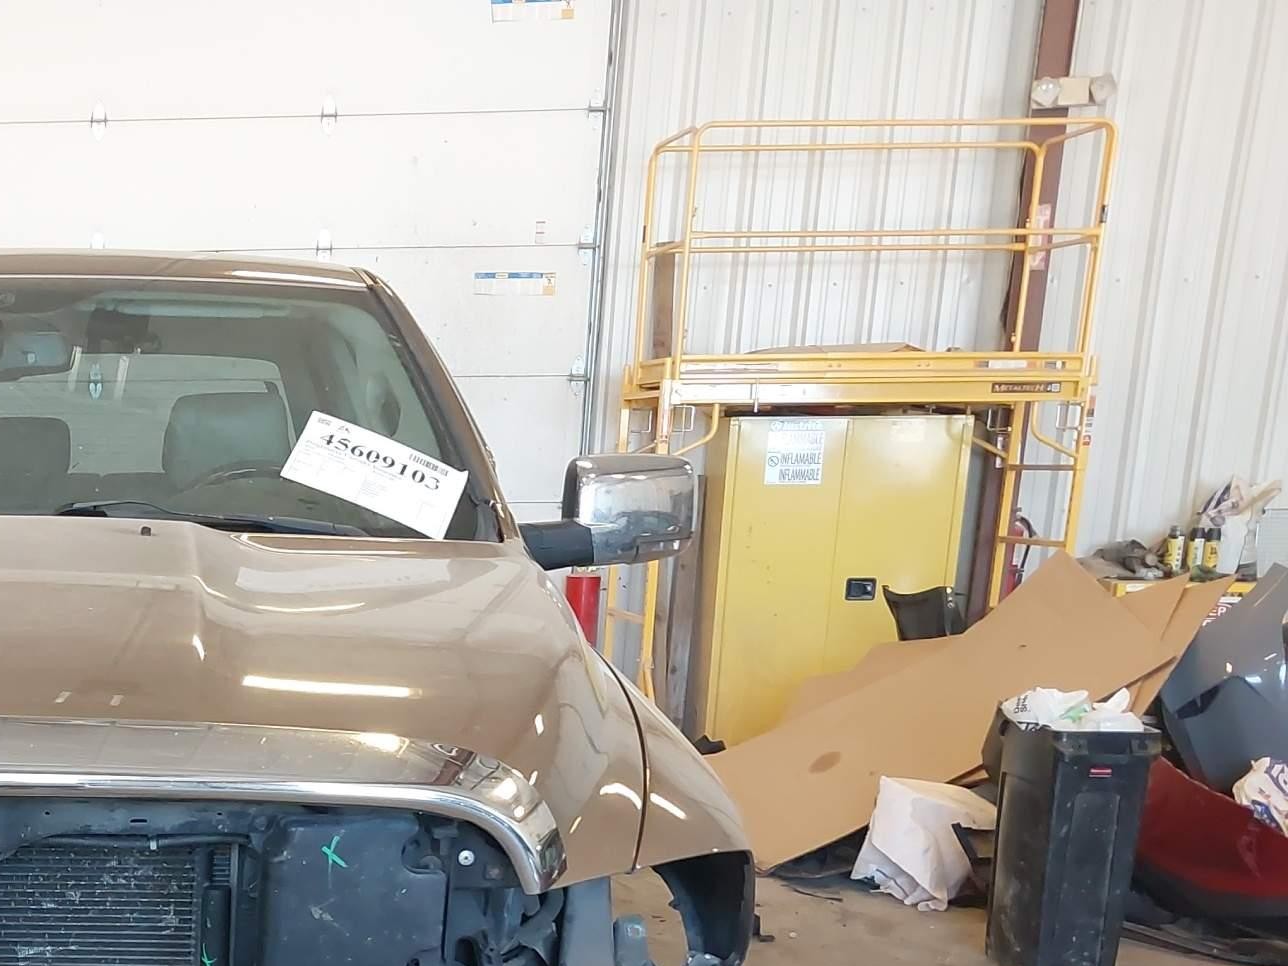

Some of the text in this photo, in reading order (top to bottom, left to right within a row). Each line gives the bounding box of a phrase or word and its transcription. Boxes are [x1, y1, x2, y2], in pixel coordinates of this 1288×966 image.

[320, 432, 441, 492] 45609103
[780, 452, 822, 465] INFLAMABLE
[778, 468, 820, 481] INFLAMMABLE
